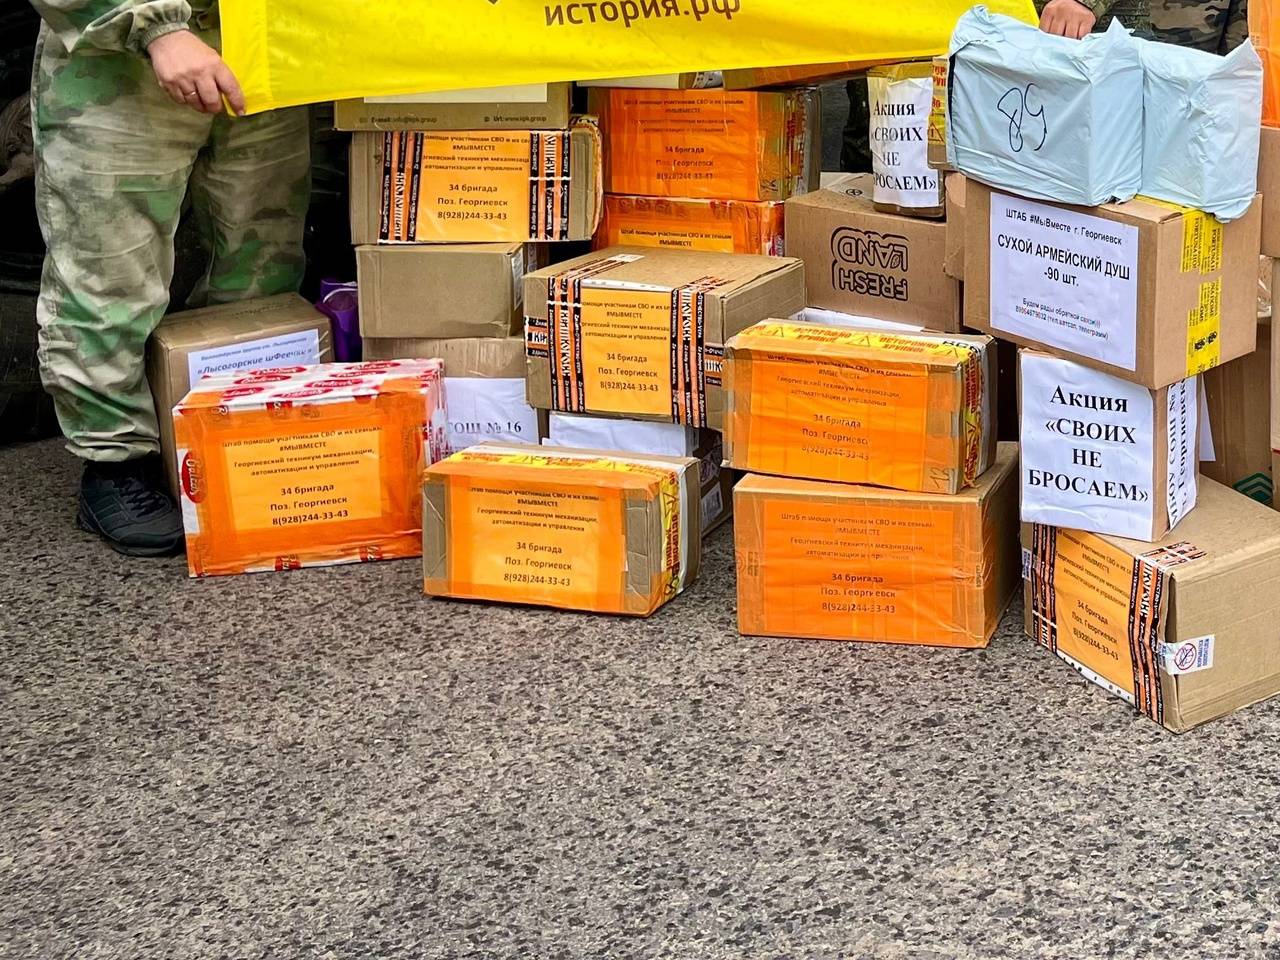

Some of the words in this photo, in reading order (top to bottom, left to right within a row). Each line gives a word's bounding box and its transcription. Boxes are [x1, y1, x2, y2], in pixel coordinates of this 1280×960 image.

[873, 102, 915, 120] Акция
[871, 127, 923, 141] «СВОИХ
[882, 152, 900, 166] НЕ
[449, 184, 460, 192] 34
[462, 184, 497, 193] бригада
[437, 197, 457, 205] Поз.
[459, 197, 508, 207] Георгиевск
[437, 211, 507, 221] 8(928)244-33-43
[1006, 209, 1027, 222] ШТАБ
[1030, 215, 1071, 233] #МыВместе
[1074, 227, 1079, 235] г.
[1081, 227, 1122, 245] Георгиевск
[838, 236, 908, 272] LAND
[998, 234, 1033, 254] СУХОЙ
[1035, 242, 1102, 273] АРМЕЙСКИЙ
[1104, 261, 1130, 281] ДУШ
[839, 267, 908, 301] FRESH
[1044, 267, 1060, 281] -90
[1062, 273, 1079, 287] шт.
[607, 311, 642, 319] #МЫВМЕСТЕ
[1023, 297, 1038, 309] Будем
[1040, 300, 1054, 313] рады
[1056, 304, 1079, 321] обратной
[607, 353, 615, 361] 34
[617, 353, 647, 363] бригада
[598, 367, 615, 375] Поз.
[616, 368, 658, 378] Георгиевск
[600, 381, 659, 392] 8(928)244-33-43
[1050, 384, 1128, 413] Акция
[487, 423, 501, 434] №
[507, 421, 522, 433] 16
[826, 415, 861, 429] бригада
[1046, 418, 1136, 444] «СВОИХ
[279, 442, 327, 452] #МЫВМЕСТЕ
[234, 455, 285, 468] Георгиевский
[286, 454, 321, 464] техникум
[323, 449, 375, 460] механизации,
[1072, 448, 1102, 468] НЕ
[251, 464, 308, 477] автоматизации
[316, 460, 359, 471] управления
[281, 487, 292, 496] 34
[294, 483, 334, 495] бригада
[1028, 469, 1148, 502] БРОСАЕМ»
[270, 502, 291, 512] Поз.
[293, 497, 347, 510] Георгиевск
[272, 510, 348, 526] 8(928)244-33-43
[523, 510, 554, 519] техникум
[548, 524, 584, 532] управления
[516, 542, 526, 550] 34
[528, 543, 562, 554] бригада
[505, 556, 523, 566] Поз.
[525, 558, 572, 570] Георгиевск
[503, 572, 570, 586] 8(928)244-33-43
[832, 574, 842, 582] 34
[845, 574, 883, 584] бригада
[821, 603, 895, 614] 8(928)244-33-43
[1077, 600, 1085, 611] 34
[1085, 604, 1109, 625] бригада
[1072, 611, 1084, 625] Поз.
[1084, 619, 1118, 645] Георгиевск
[1073, 628, 1119, 661] 8(928)244-33-43
